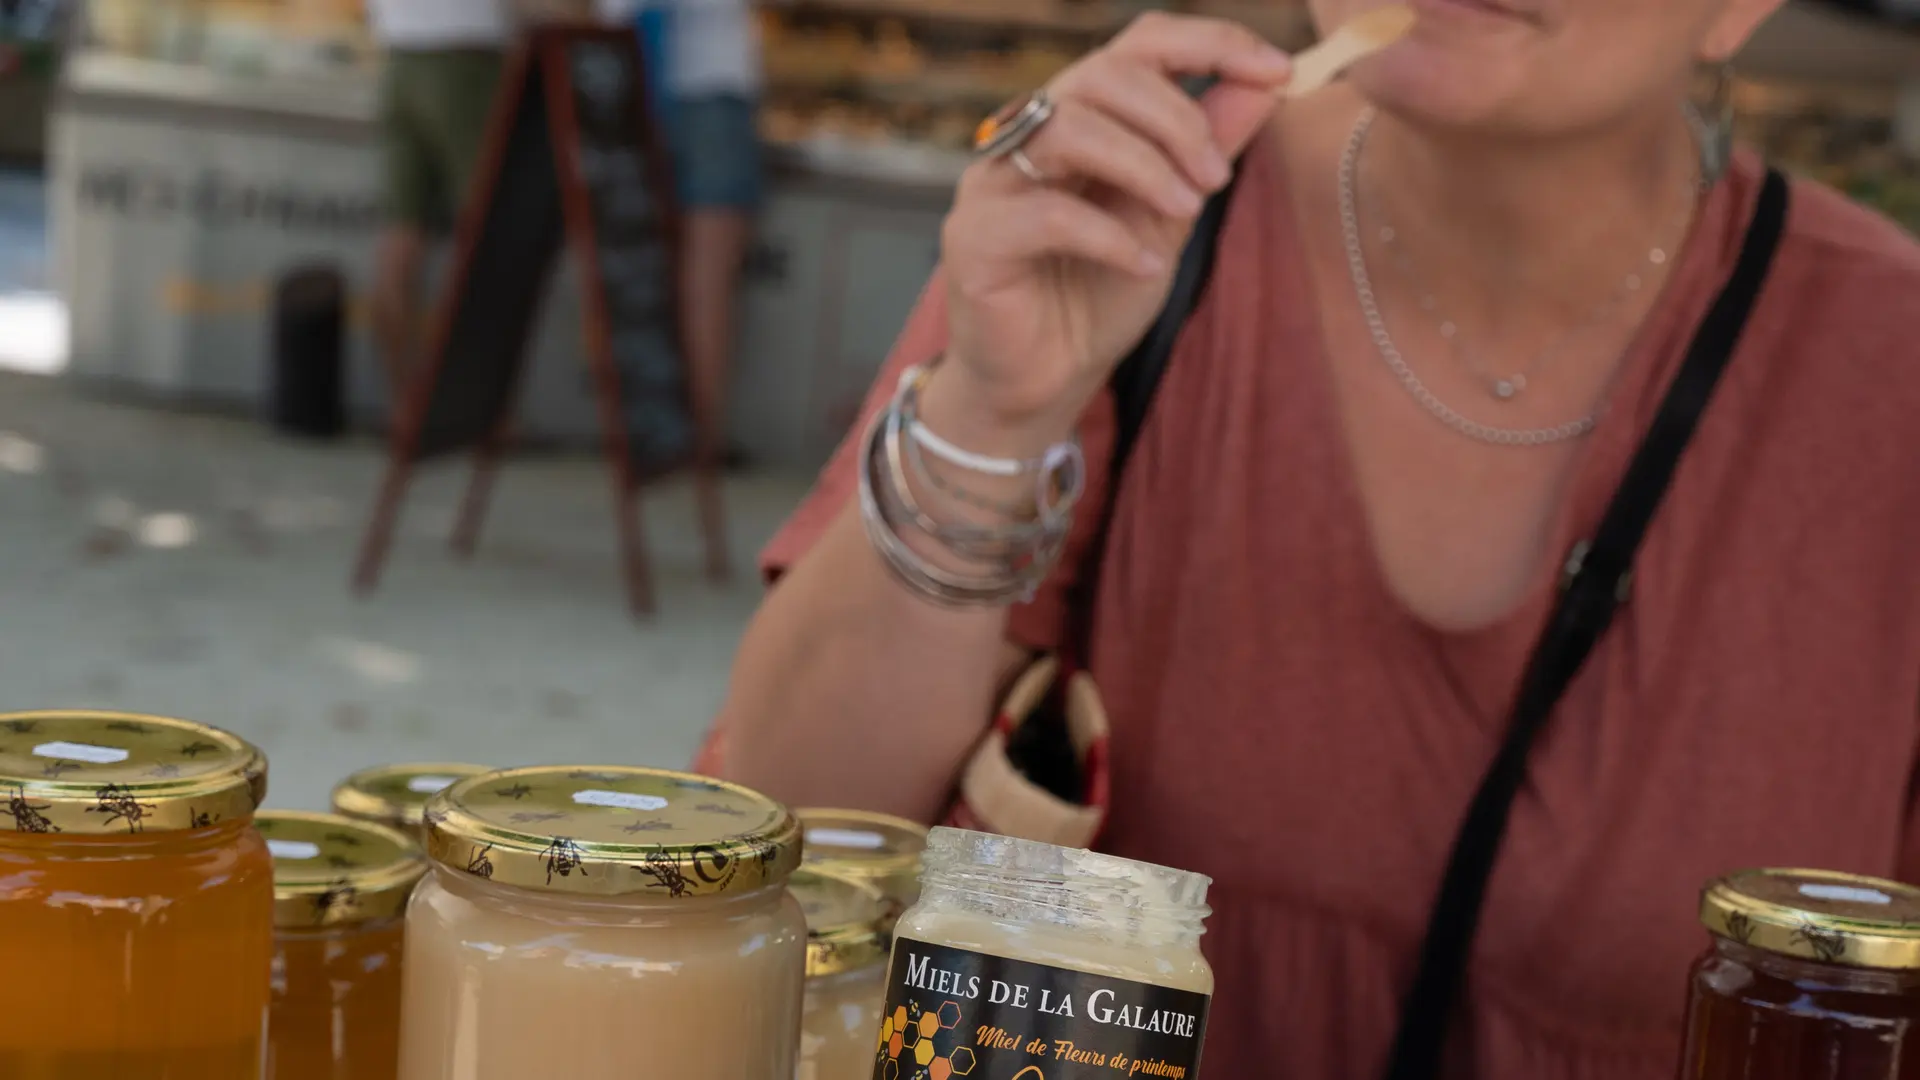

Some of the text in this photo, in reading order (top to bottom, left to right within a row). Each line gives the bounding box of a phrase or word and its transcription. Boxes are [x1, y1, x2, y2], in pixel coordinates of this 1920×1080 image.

[904, 953, 1196, 1038] MIELS DE LA GALAURE
[976, 1025, 1186, 1080] Miel de Fleurs de printemps
